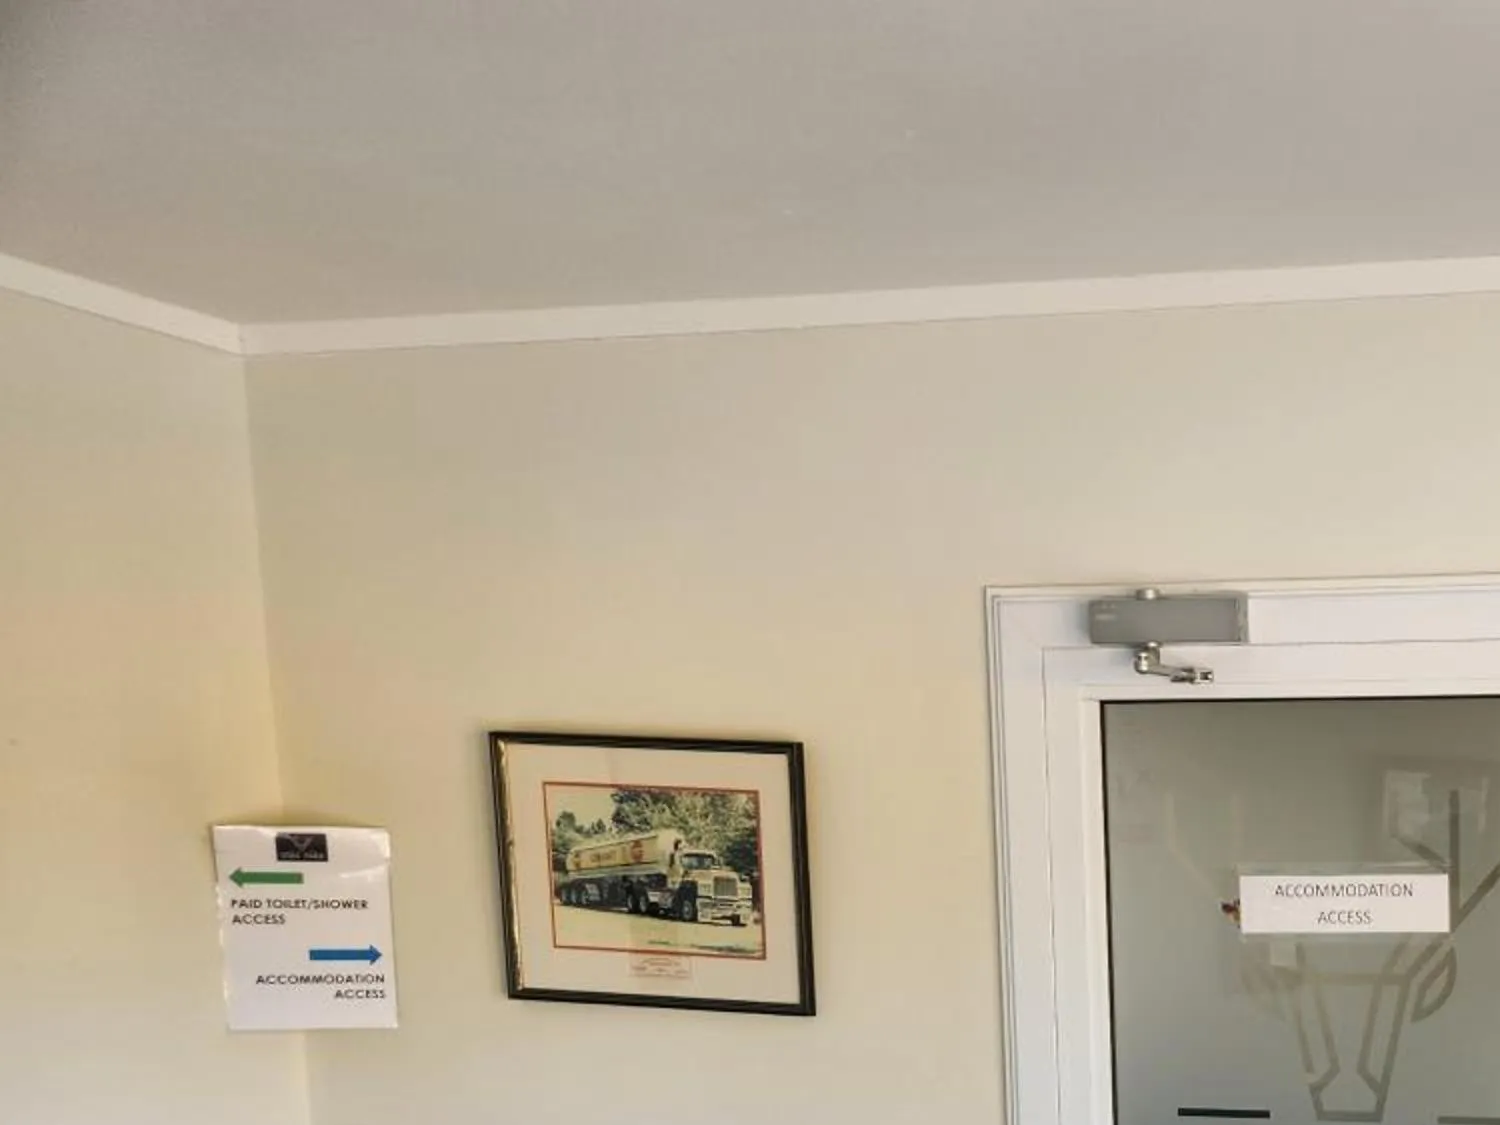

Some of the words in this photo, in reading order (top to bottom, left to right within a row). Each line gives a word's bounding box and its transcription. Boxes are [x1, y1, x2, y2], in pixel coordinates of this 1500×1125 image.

[1274, 883, 1414, 898] ACCOMMODATION
[231, 898, 263, 909] PAID
[266, 899, 369, 911] TOILET/SHOWER
[231, 913, 286, 925] ACCESS
[1317, 910, 1373, 926] ACCESS
[255, 973, 386, 986] ACCOMMODATION
[334, 989, 386, 1000] ACCESS
